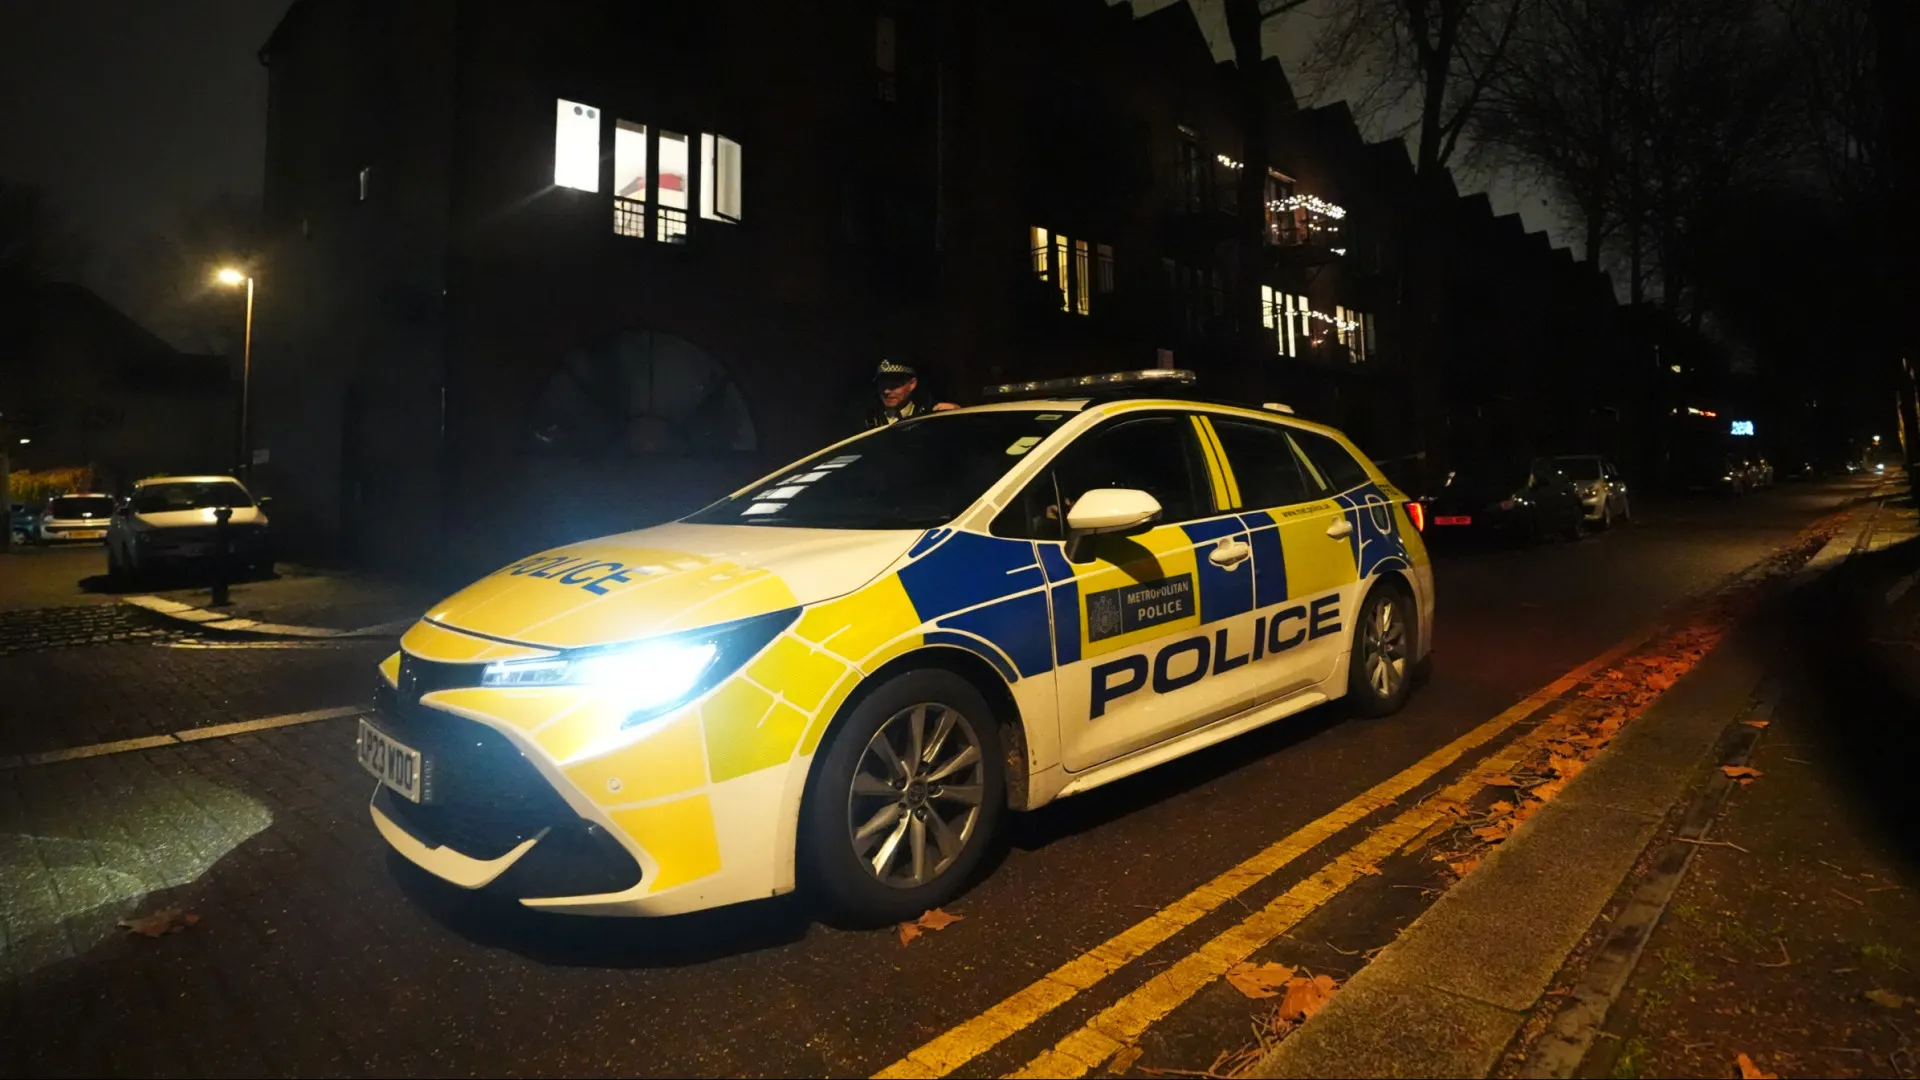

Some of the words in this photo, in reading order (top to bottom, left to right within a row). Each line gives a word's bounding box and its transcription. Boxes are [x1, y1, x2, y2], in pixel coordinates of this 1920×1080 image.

[498, 557, 633, 595] POLICE
[1127, 581, 1189, 604] METROPOLITAN
[1138, 600, 1182, 621] POLICE
[1090, 593, 1342, 720] POLICE
